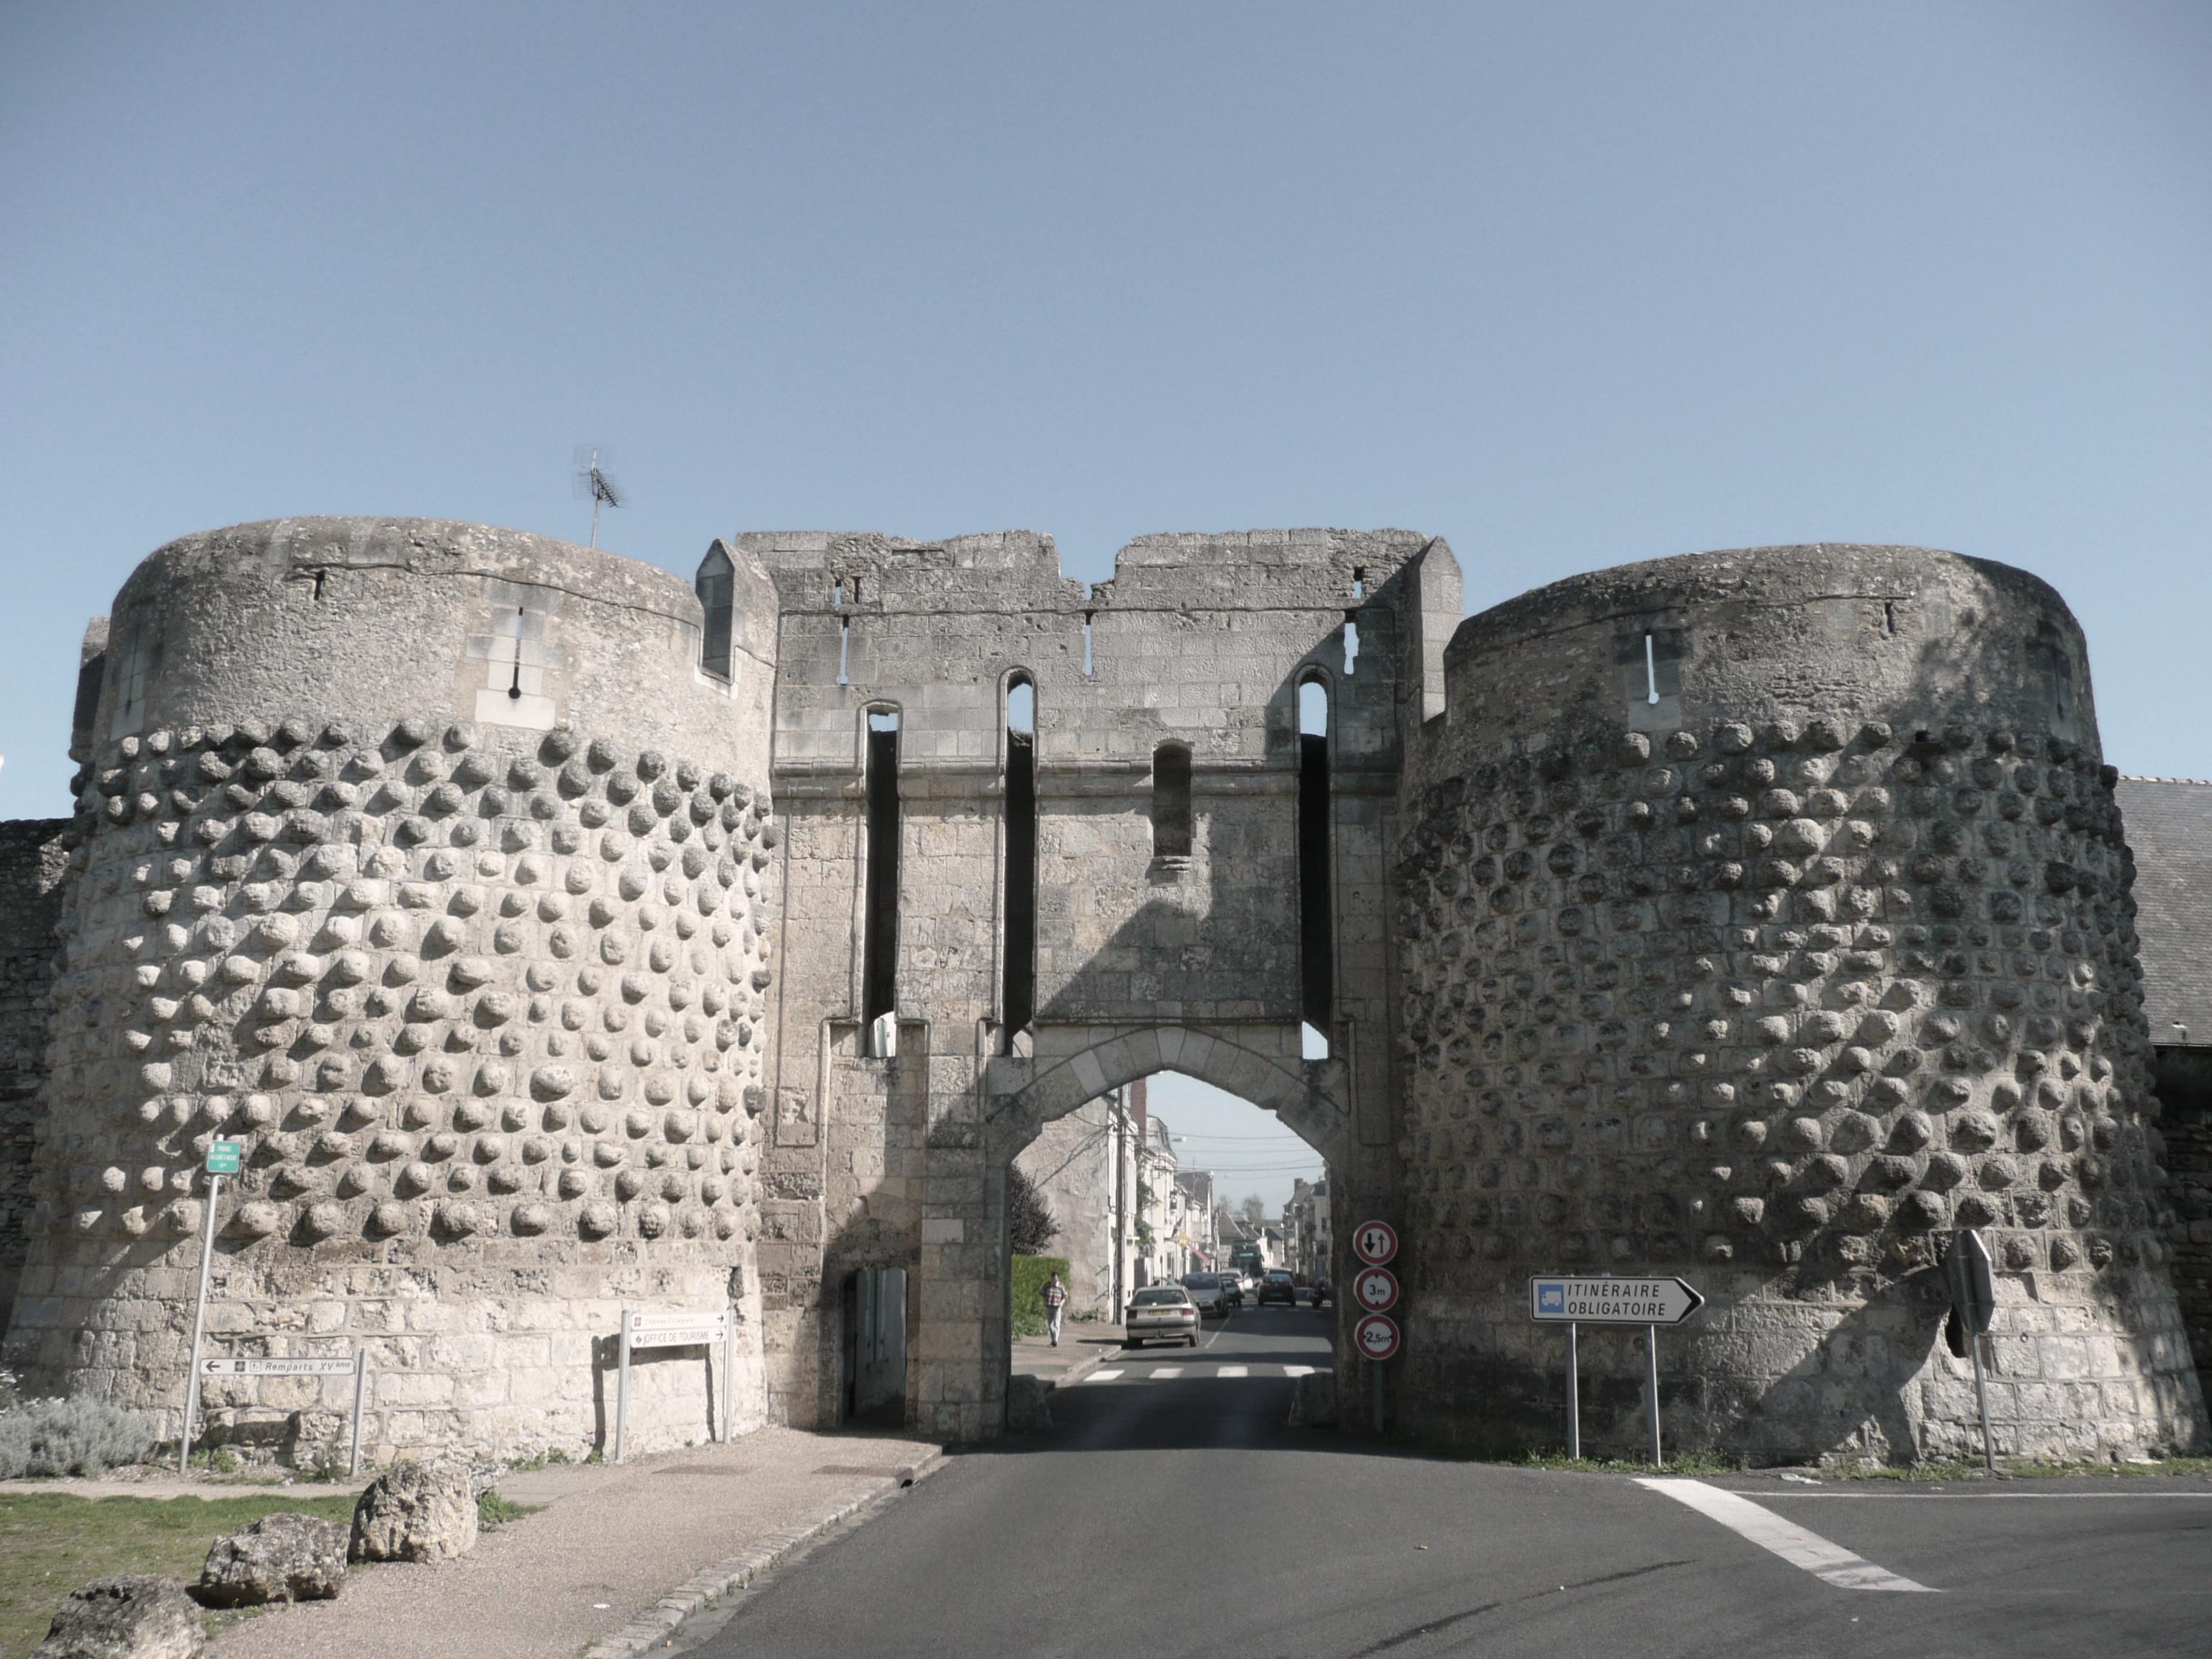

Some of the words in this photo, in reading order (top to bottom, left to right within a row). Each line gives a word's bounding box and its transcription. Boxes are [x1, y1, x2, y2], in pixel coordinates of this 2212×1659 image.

[1568, 1281, 1660, 1298] ITINÉRAIRE
[1568, 1302, 1665, 1316] OBLIGATOIRE
[645, 1333, 667, 1344] OFFICE
[668, 1332, 678, 1342] DE
[679, 1330, 709, 1341] TOURISME
[265, 1362, 314, 1373] Remparts
